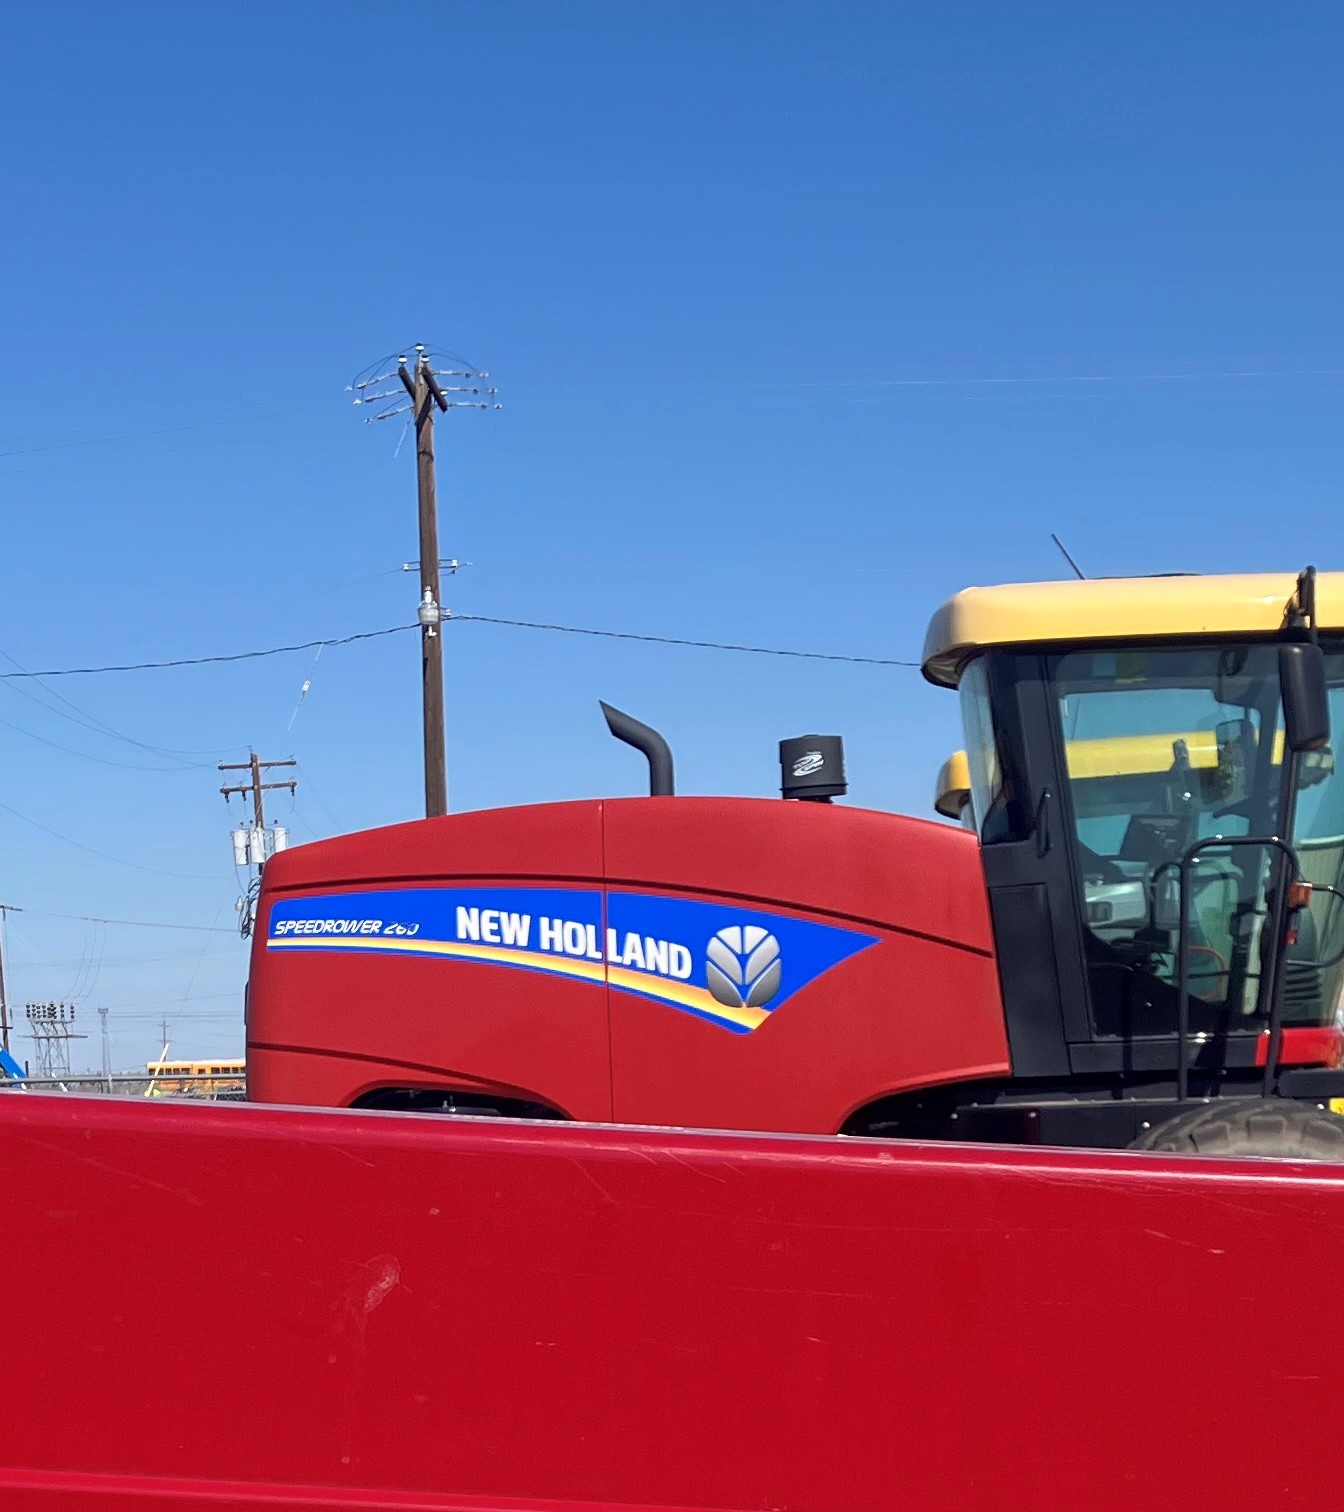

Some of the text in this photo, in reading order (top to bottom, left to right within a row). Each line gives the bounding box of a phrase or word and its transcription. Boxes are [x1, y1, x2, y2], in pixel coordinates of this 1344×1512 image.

[274, 919, 383, 936] SPEEDROWER
[456, 906, 692, 980] NEW HOLLAND
